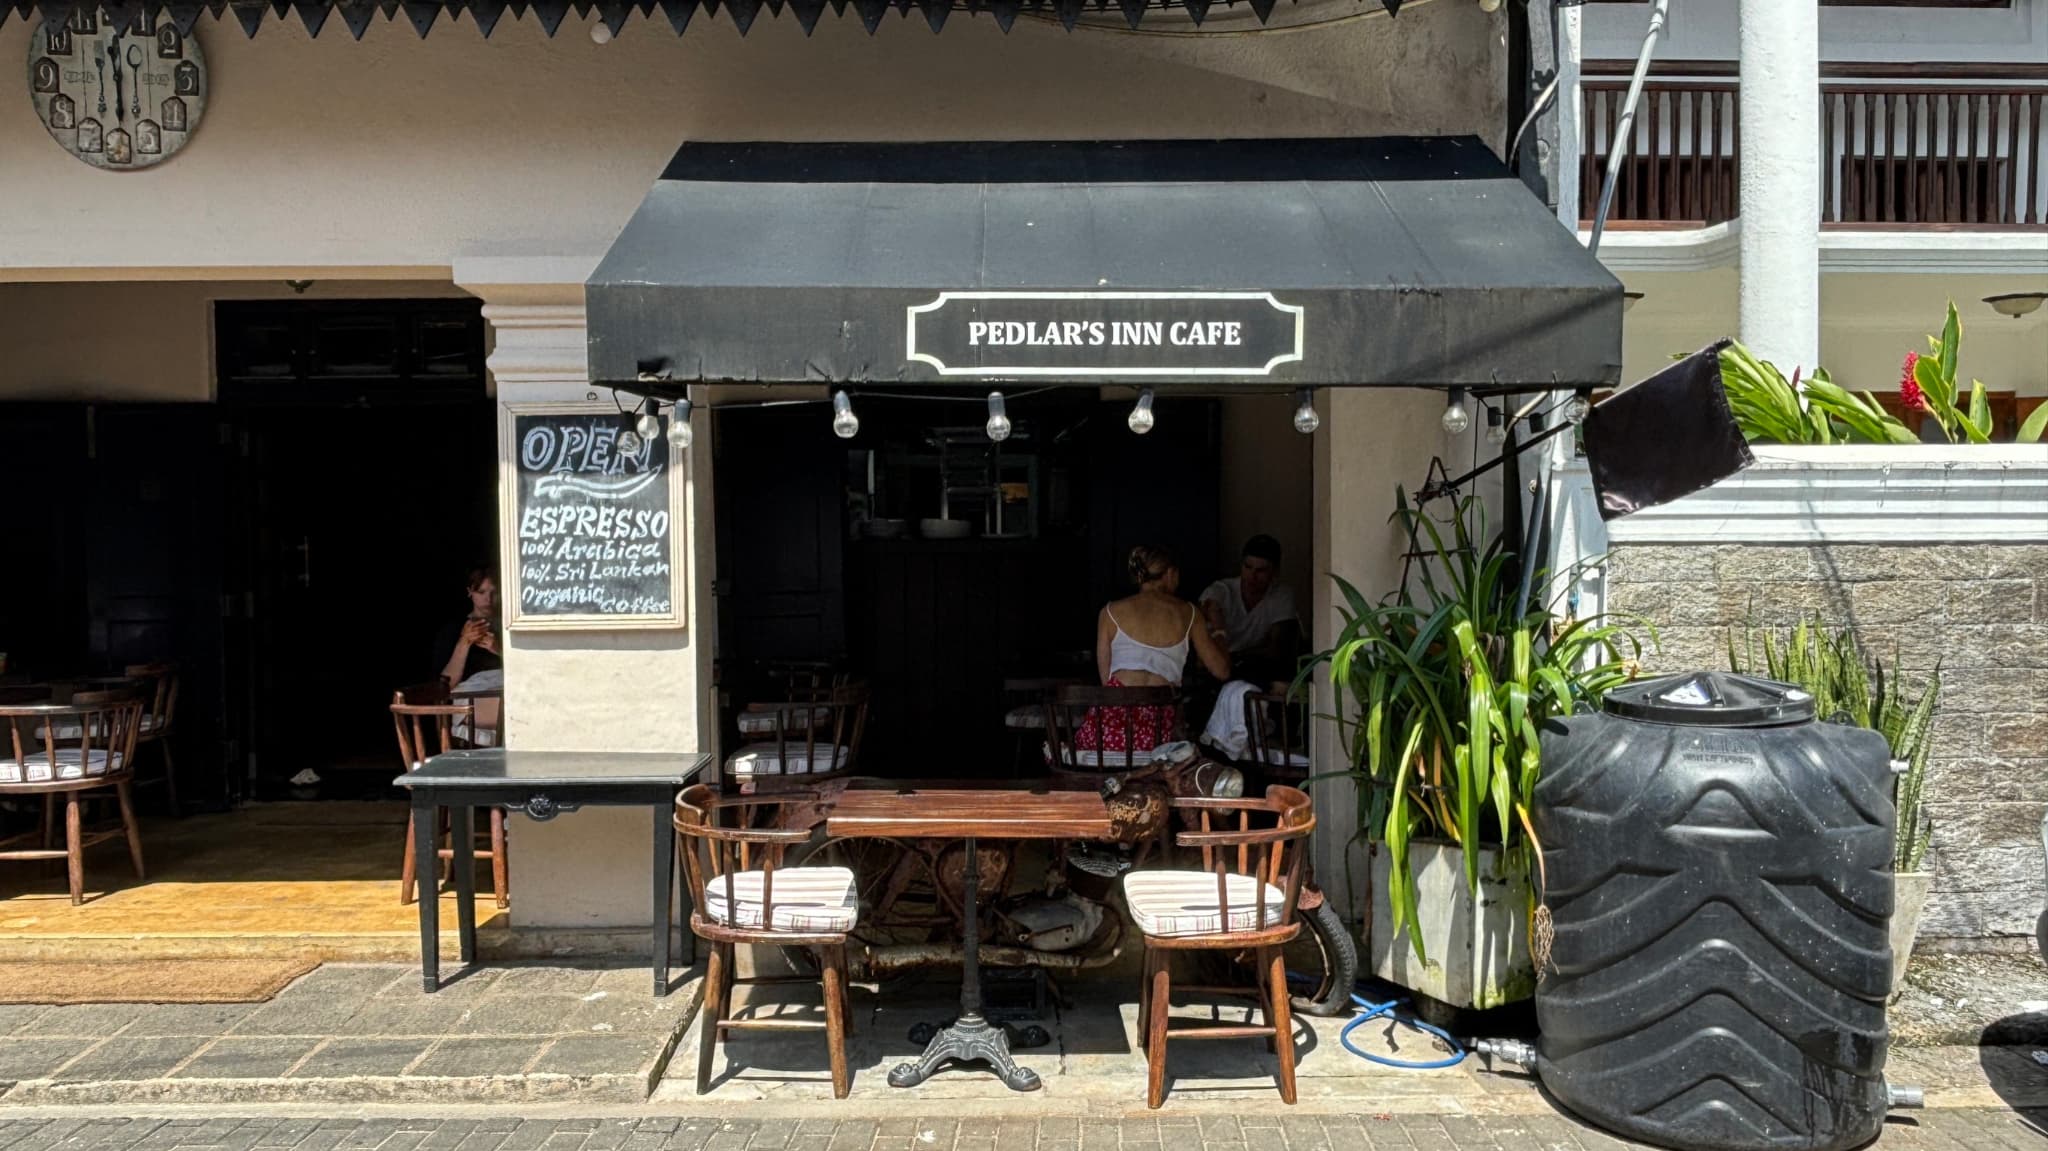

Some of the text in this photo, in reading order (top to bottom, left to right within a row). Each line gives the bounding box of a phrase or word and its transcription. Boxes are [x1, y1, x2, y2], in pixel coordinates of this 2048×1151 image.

[40, 63, 54, 88] 9
[181, 66, 194, 91] 3
[968, 321, 1242, 346] PEDLAR'S INN CAFE
[519, 504, 669, 540] ESPRESSO
[521, 536, 662, 560] 100% Arabica
[521, 561, 670, 584] 100% Sri Lankan
